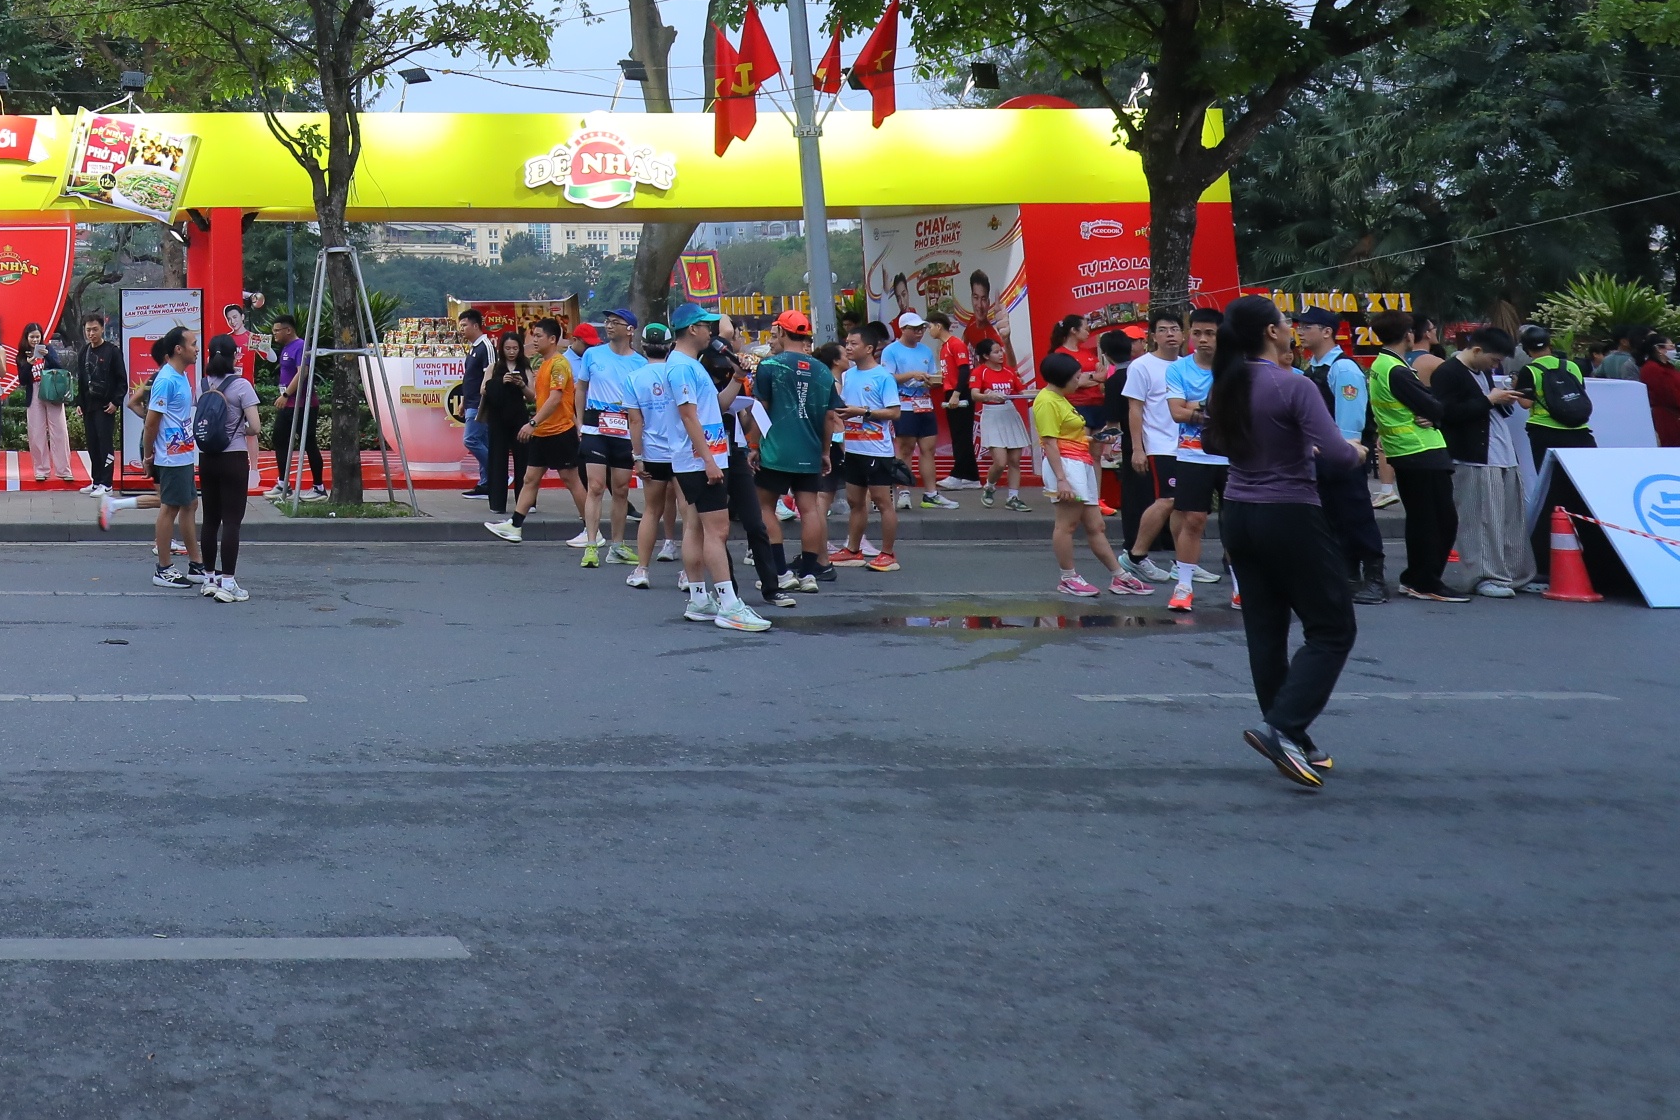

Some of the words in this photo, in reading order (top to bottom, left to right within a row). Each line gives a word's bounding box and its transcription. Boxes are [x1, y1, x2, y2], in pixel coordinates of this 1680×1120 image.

[87, 144, 110, 160] PHỞ
[109, 151, 126, 165] BÒ
[528, 148, 572, 184] ĐỆ
[580, 148, 674, 186] NHẤT
[915, 215, 947, 238] CHẠY
[946, 220, 961, 231] CÙNG
[914, 234, 929, 249] PHỞ
[930, 232, 940, 246] ĐỆ
[0, 258, 39, 276] NHẤT
[1079, 260, 1098, 276] TỰ
[1100, 257, 1129, 272] HÀO
[1132, 258, 1150, 268] LA
[1072, 282, 1104, 298] TINH
[1107, 279, 1138, 292] HOA
[719, 292, 774, 319] NHIỆT
[1301, 288, 1358, 313] KHÓA
[1365, 292, 1413, 313] XVI
[488, 314, 515, 326] NHẤT
[423, 369, 441, 378] THỊT
[422, 391, 440, 405] QUÁN
[609, 418, 626, 426] 5660
